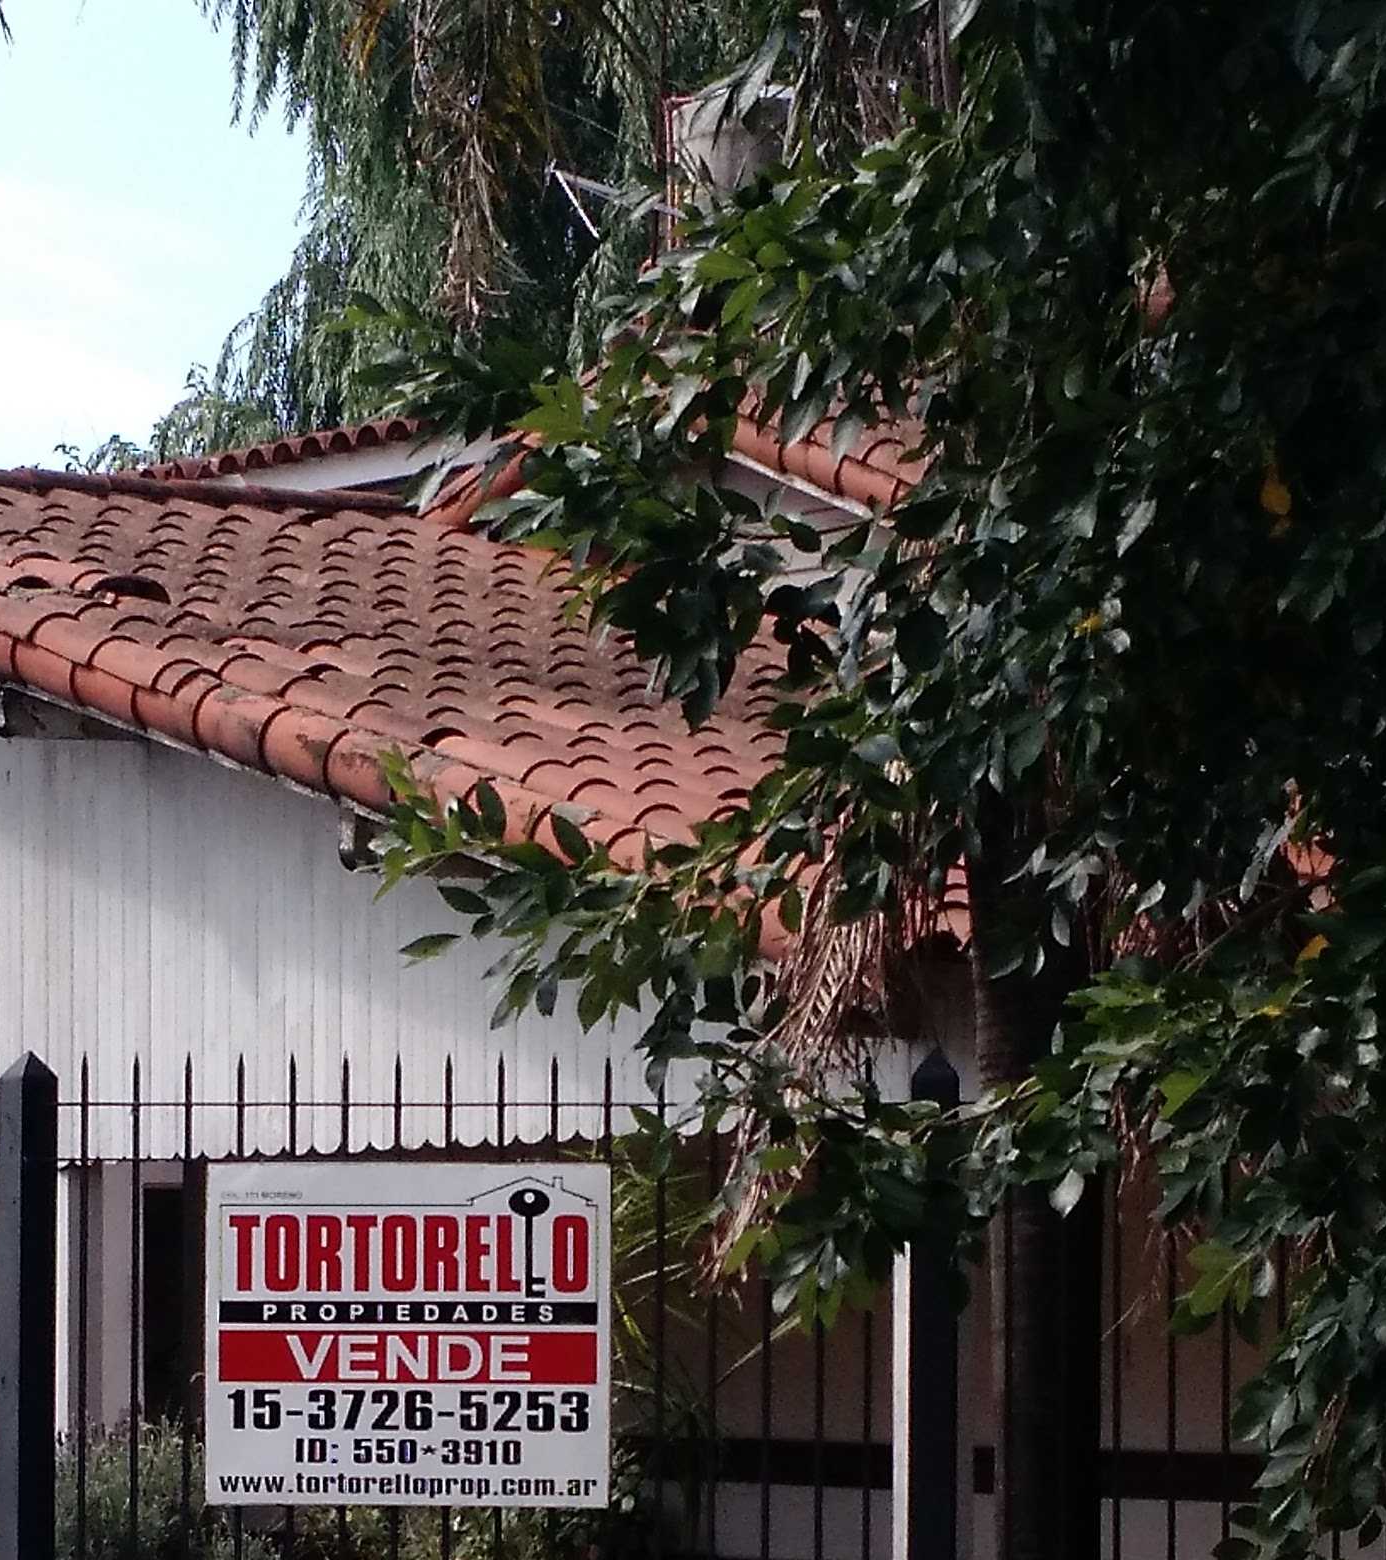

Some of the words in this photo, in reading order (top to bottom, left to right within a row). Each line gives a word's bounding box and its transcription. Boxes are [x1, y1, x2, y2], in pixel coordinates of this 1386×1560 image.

[229, 1215, 589, 1298] TORTORELLO
[263, 1305, 554, 1323] PROPIEDADES
[286, 1335, 531, 1381] VENDE
[227, 1389, 589, 1432] 15-3726-5253
[295, 1438, 339, 1464] ID:
[219, 1473, 598, 1498] www.tortorelloprop.com.ar
